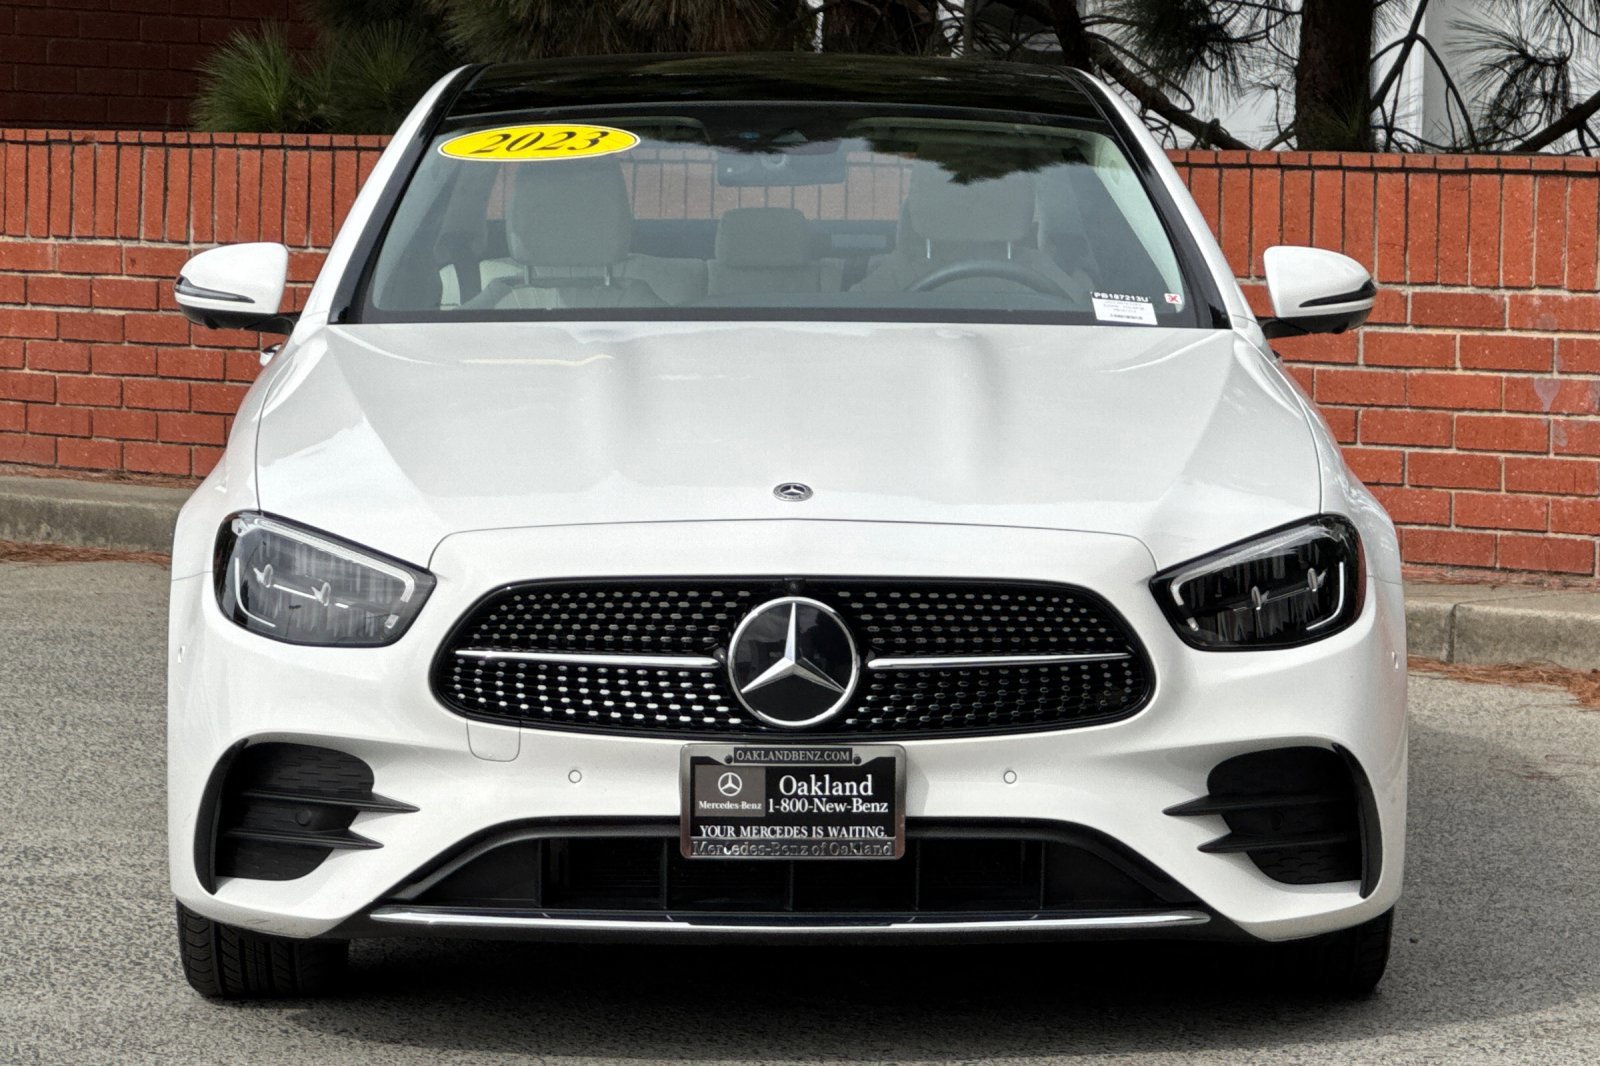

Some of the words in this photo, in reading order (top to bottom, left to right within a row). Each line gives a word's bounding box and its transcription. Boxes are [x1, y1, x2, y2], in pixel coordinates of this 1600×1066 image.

[469, 131, 610, 154] 2023
[736, 750, 850, 762] OAKLANDBENZ.COM
[779, 774, 873, 796] Oakland
[698, 800, 762, 810] Mercedes-Benz
[768, 798, 889, 813] 1-800-New-Benz
[700, 825, 735, 837] YOUR
[740, 825, 808, 837] MERCEDES
[812, 825, 824, 837] IS
[828, 825, 887, 838] WAITING.
[692, 841, 808, 856] Mercedes-Benz
[811, 841, 827, 856] of
[829, 841, 892, 856] Oakland
